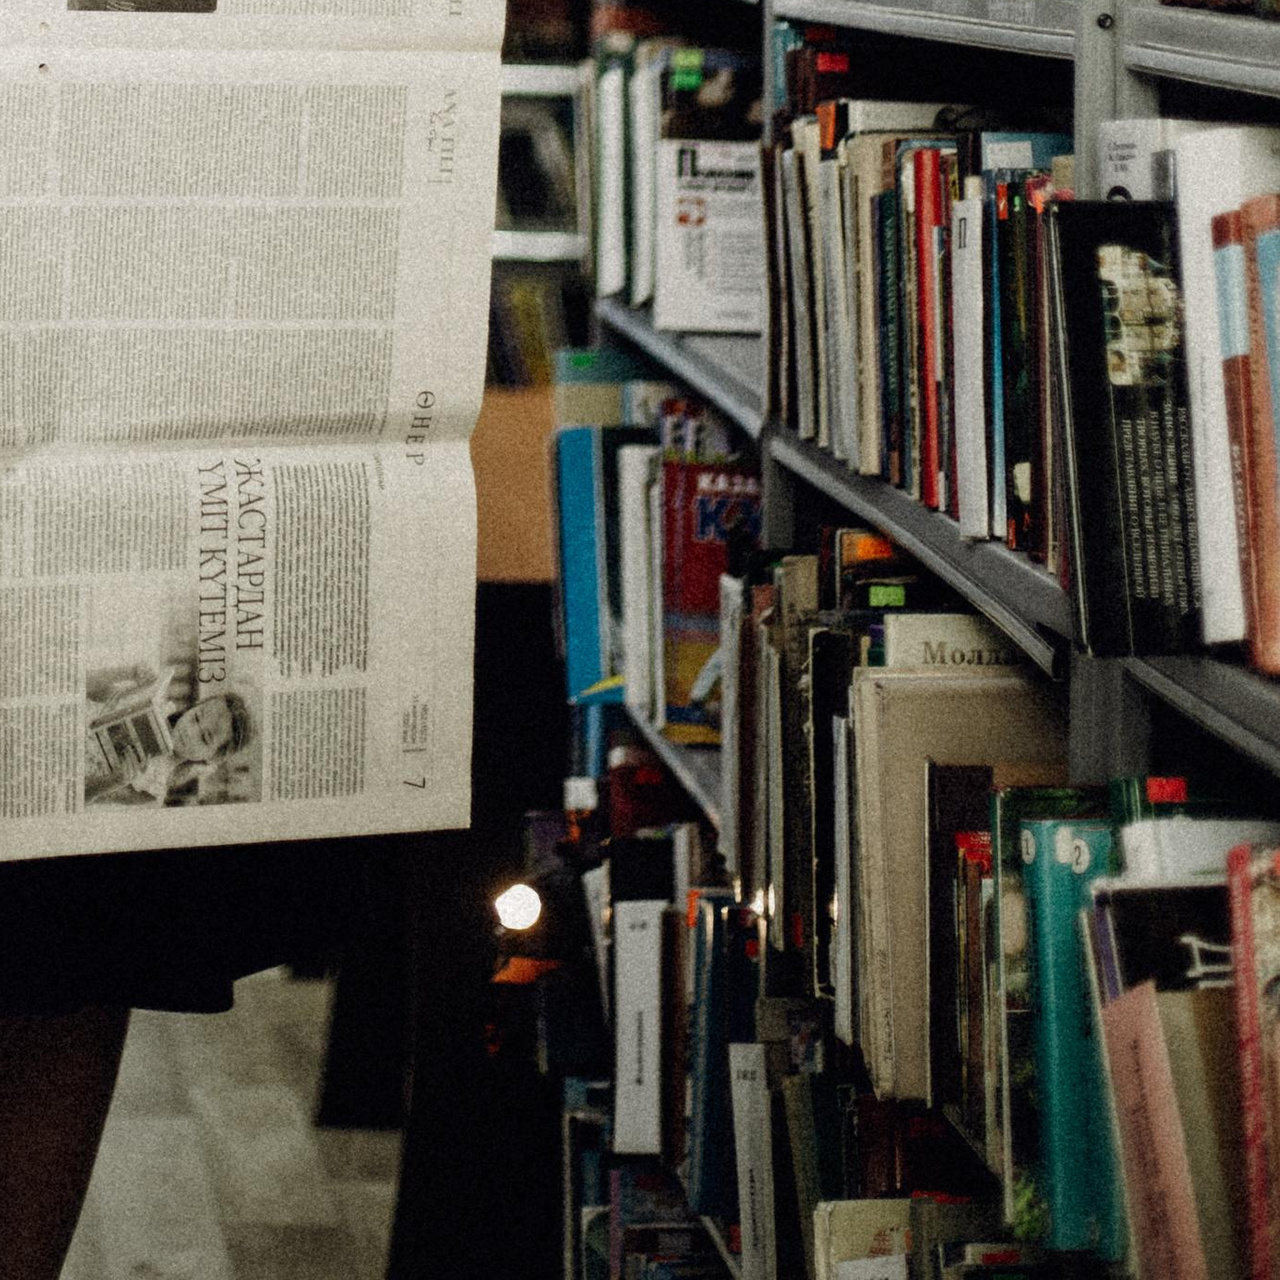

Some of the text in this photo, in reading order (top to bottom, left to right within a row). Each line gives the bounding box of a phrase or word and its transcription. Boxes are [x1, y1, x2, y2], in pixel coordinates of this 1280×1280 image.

[405, 390, 437, 466] ӨНЕР
[196, 460, 228, 685] ҮМІТ КҮТЕМІЗ
[231, 457, 268, 652] ЖАСТАРДАН
[404, 776, 427, 790] 7
